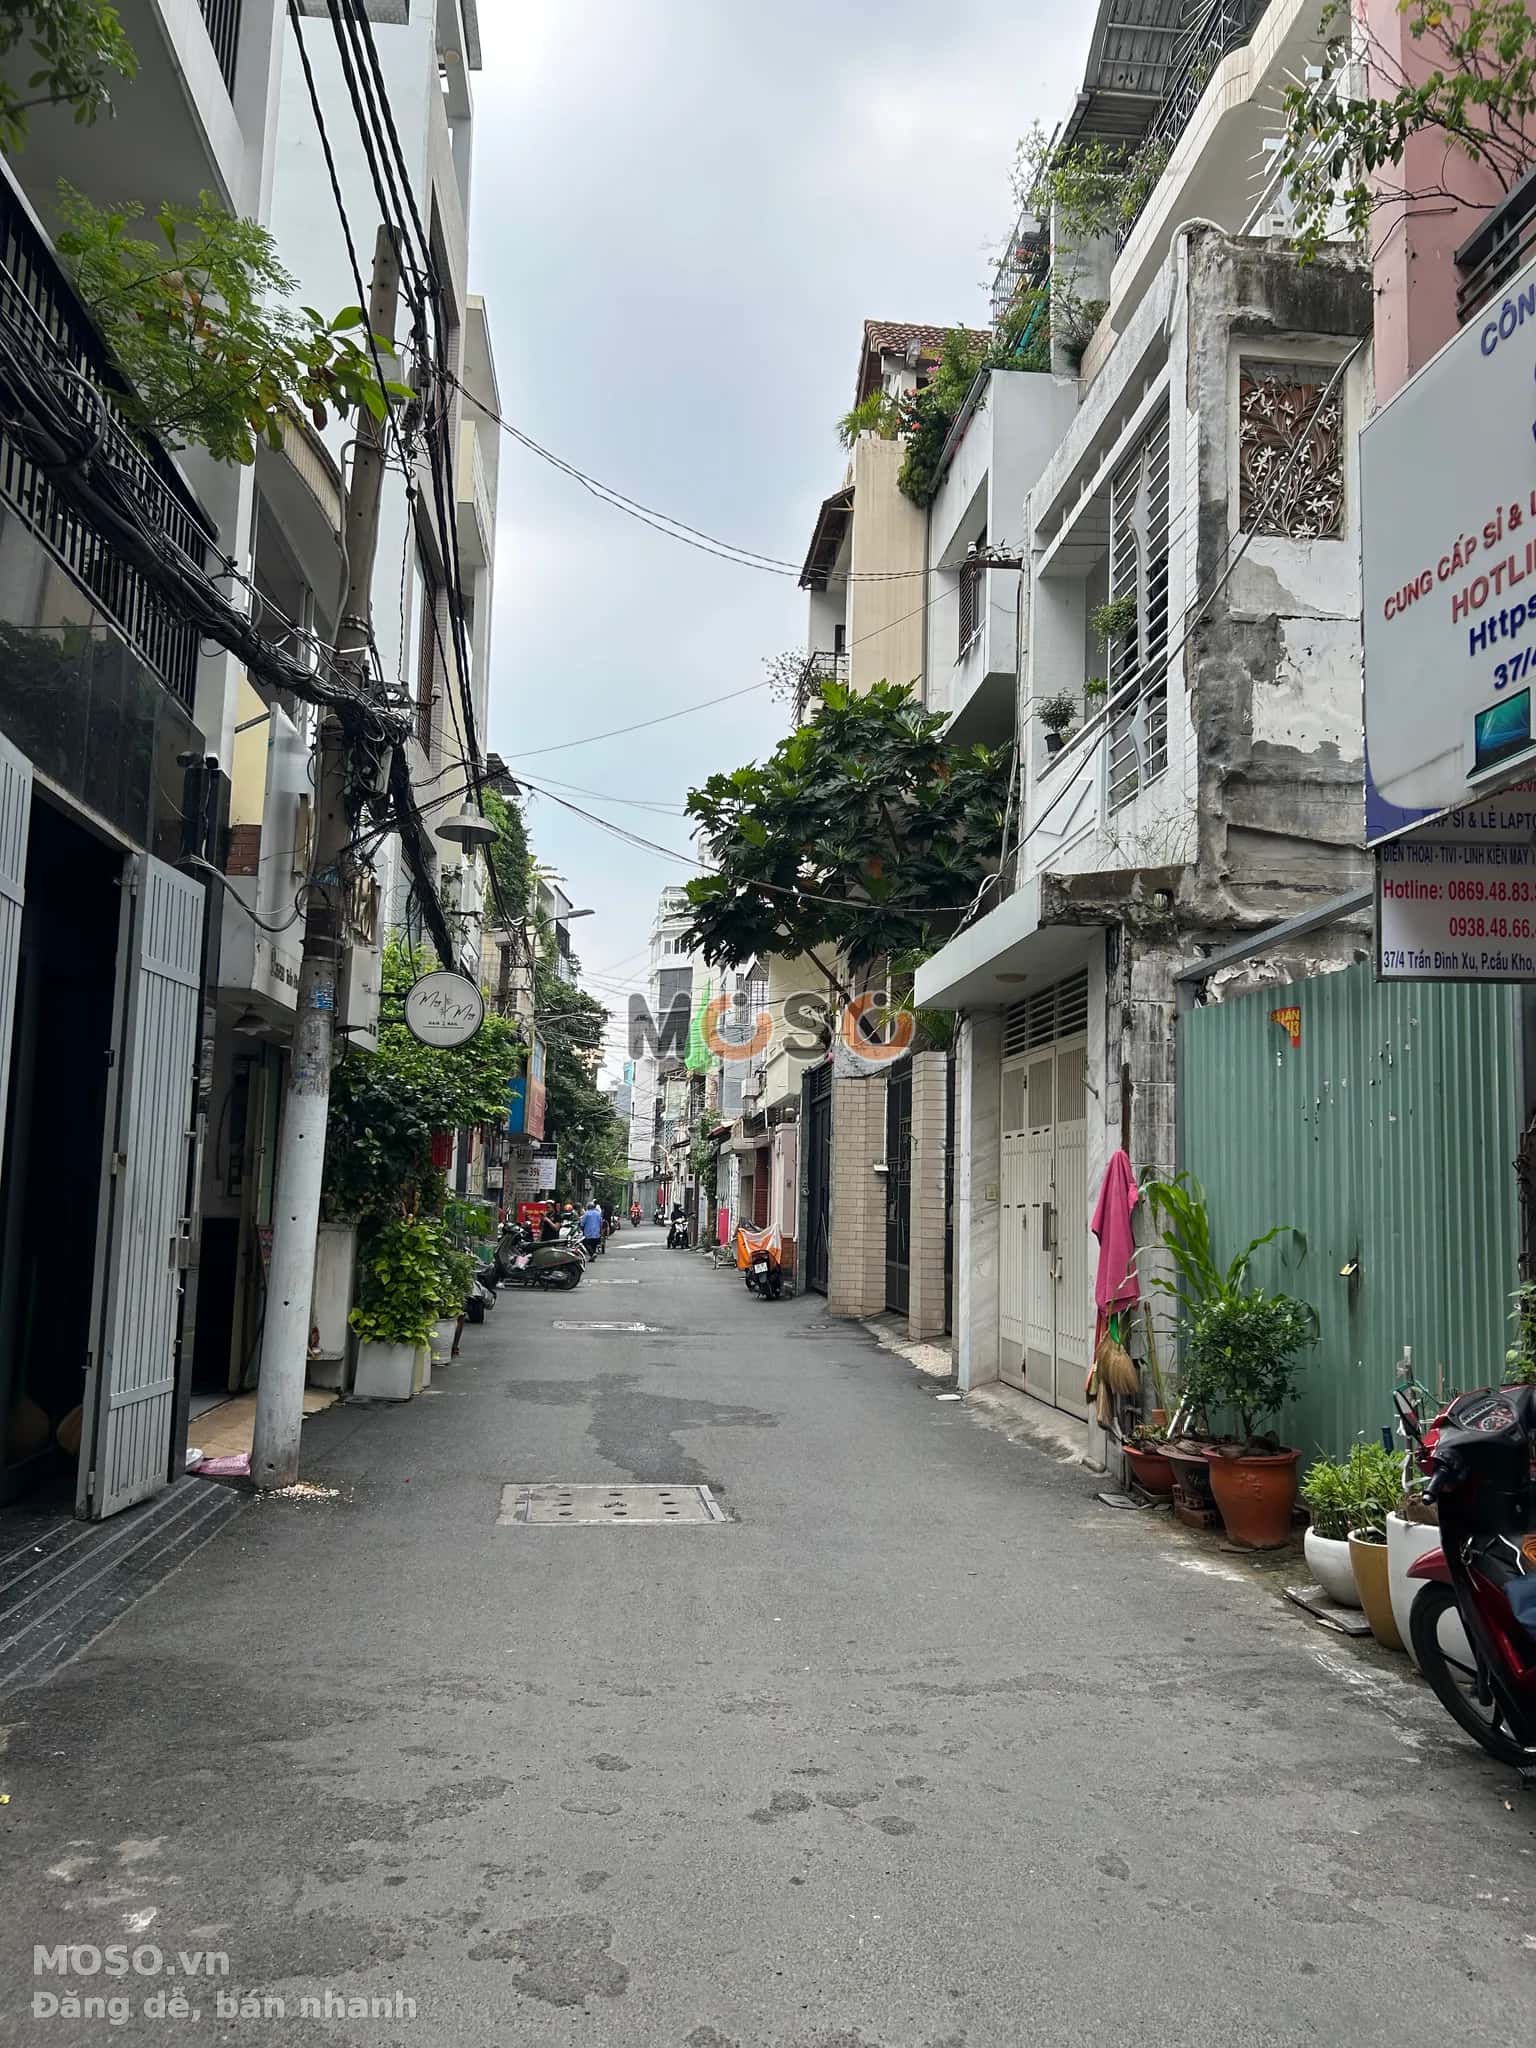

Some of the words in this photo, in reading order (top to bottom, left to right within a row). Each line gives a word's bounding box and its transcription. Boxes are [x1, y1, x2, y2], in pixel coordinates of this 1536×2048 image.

[1384, 569, 1433, 621] CUNG
[1508, 503, 1523, 531] &
[1451, 537, 1536, 624] HOTLI
[1383, 879, 1443, 900] Hotline:
[1448, 880, 1536, 901] 0869.48.83.
[1449, 917, 1536, 938] 0938.48.66.
[1383, 950, 1405, 969] 37/4
